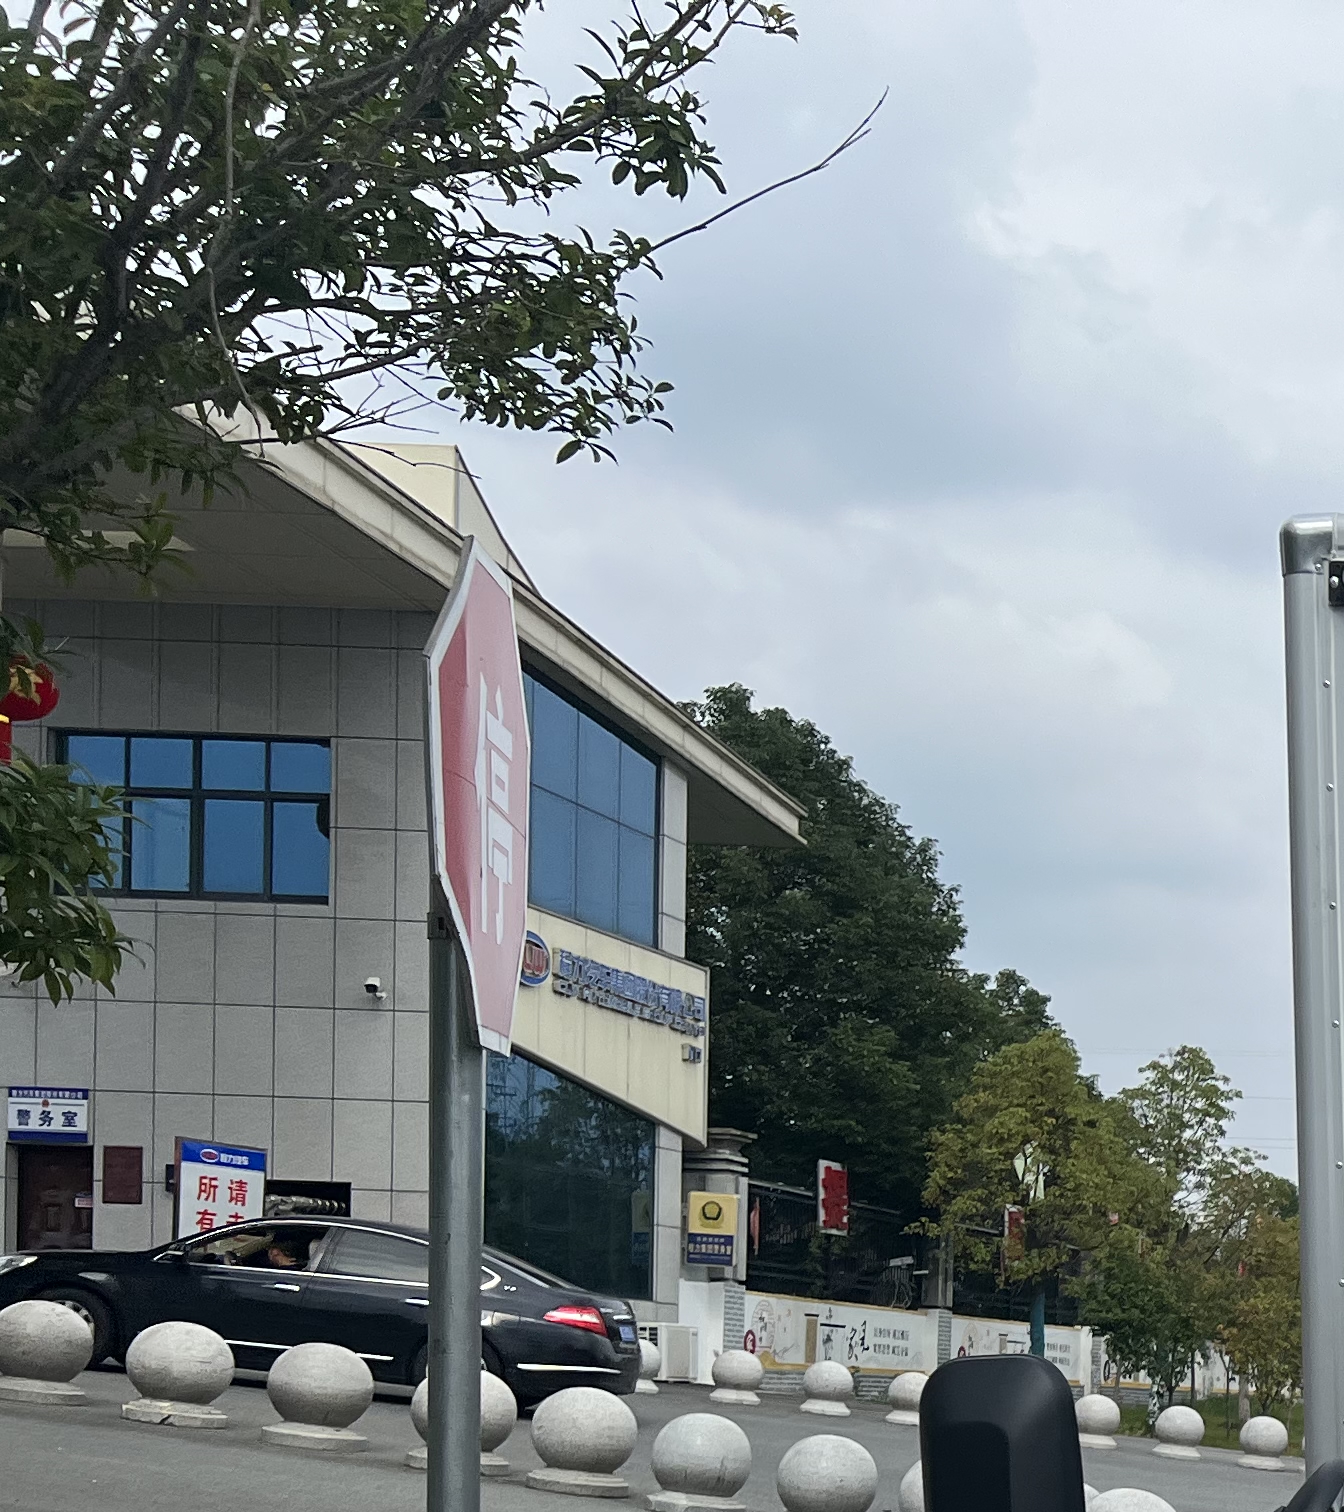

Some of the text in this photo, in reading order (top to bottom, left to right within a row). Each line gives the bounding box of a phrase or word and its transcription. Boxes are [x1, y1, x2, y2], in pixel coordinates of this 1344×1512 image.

[474, 671, 513, 945] 停
[17, 1109, 78, 1128] 警务室
